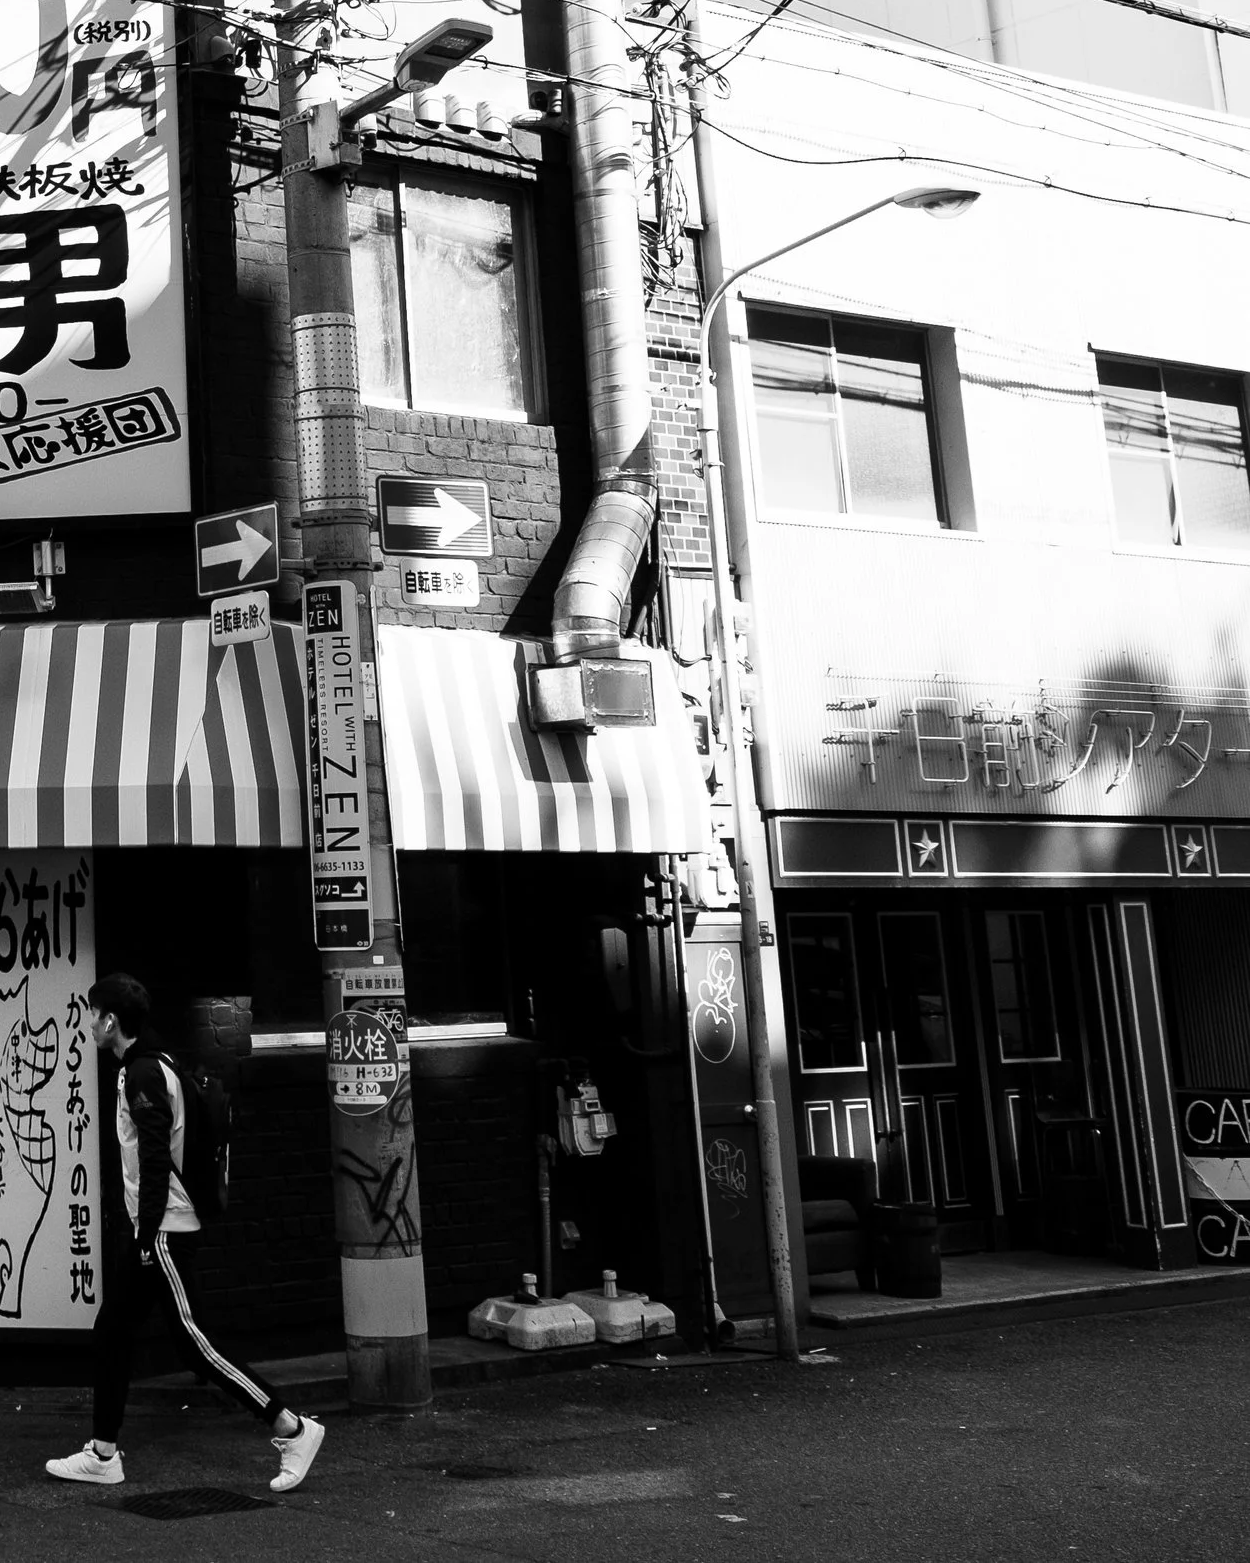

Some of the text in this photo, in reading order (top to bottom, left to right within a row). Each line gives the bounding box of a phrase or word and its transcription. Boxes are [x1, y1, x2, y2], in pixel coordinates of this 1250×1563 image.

[73, 20, 152, 44] (税別)
[310, 593, 332, 603] HOTEL
[405, 571, 474, 595] 自転車を除く
[213, 604, 266, 635] 自転車を除く
[308, 609, 339, 628] ZEN
[317, 638, 329, 752] TIMELESS RESORT
[323, 636, 361, 853] HOTEL WITH ZEN
[329, 1028, 388, 1062] 消火栓
[65, 992, 96, 1306] からあげの聖地
